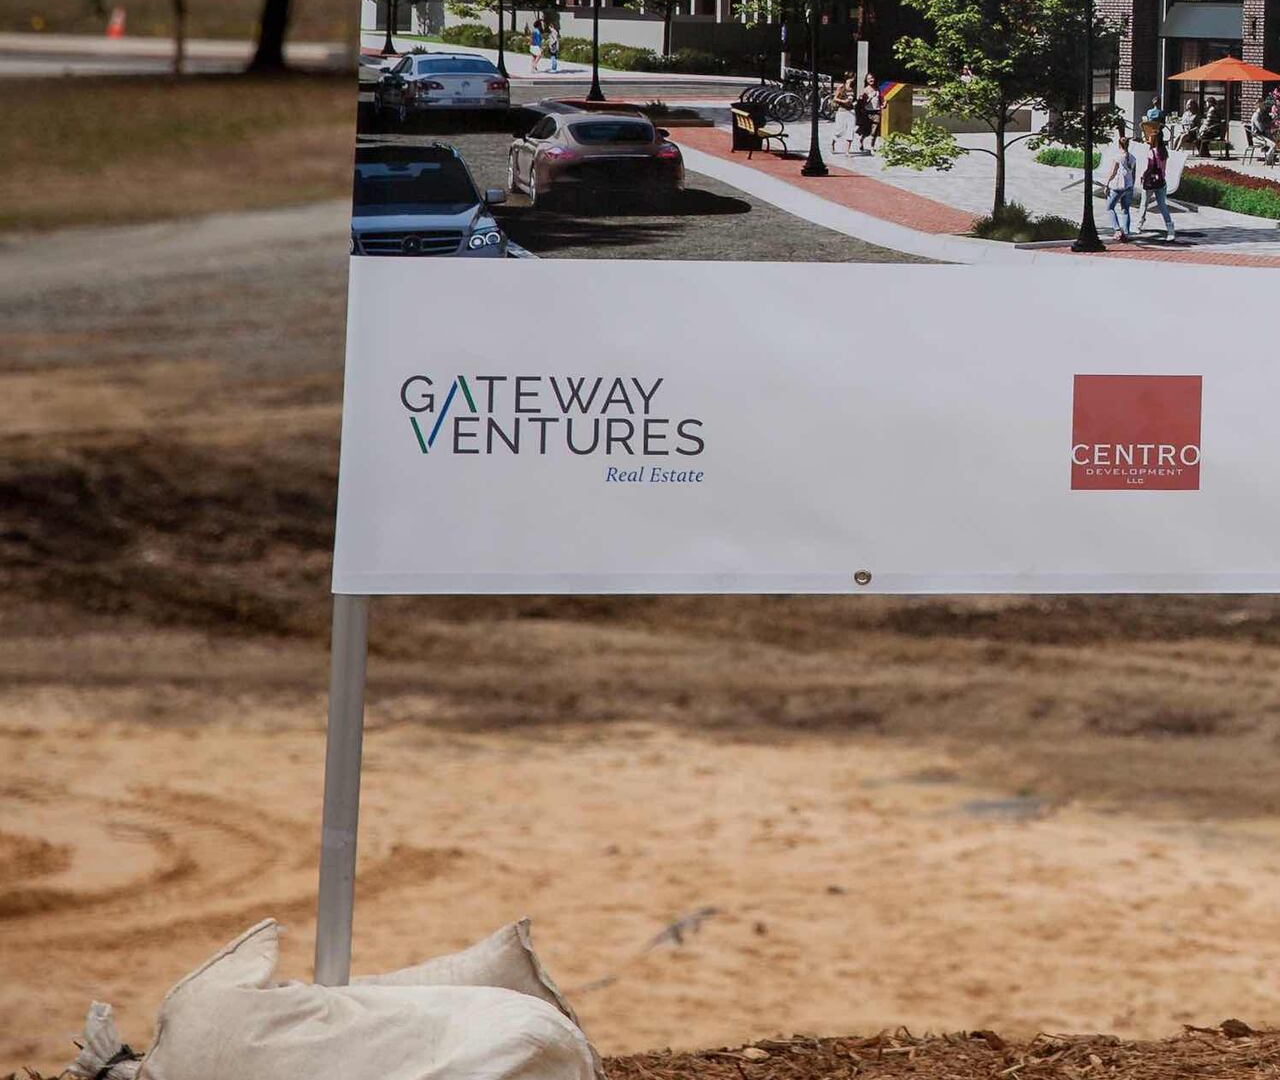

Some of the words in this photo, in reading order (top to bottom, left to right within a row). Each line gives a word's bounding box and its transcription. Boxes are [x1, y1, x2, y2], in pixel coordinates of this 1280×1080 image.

[400, 375, 664, 414] GATEWAY
[409, 416, 705, 456] VENTURES
[1072, 443, 1201, 466] CENTRO
[606, 466, 645, 483] Real
[650, 466, 705, 484] Estate
[1086, 468, 1184, 476] DEVELOPMENT
